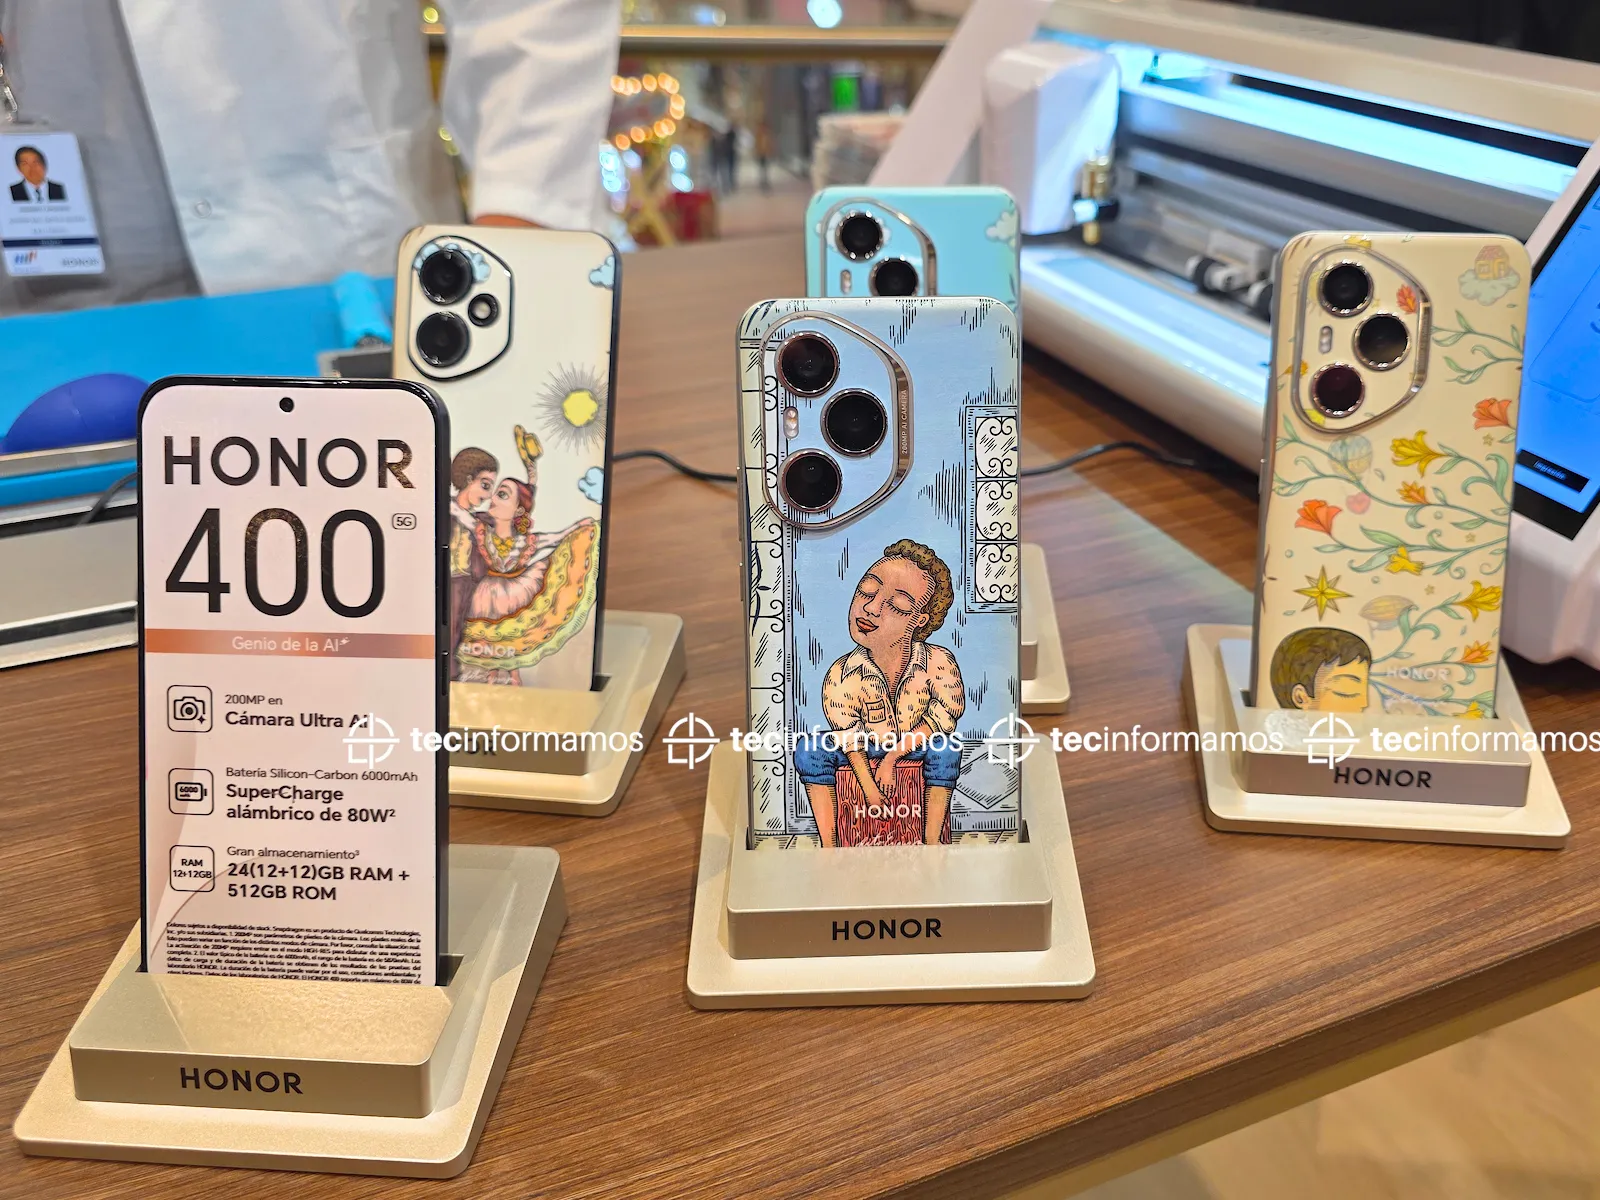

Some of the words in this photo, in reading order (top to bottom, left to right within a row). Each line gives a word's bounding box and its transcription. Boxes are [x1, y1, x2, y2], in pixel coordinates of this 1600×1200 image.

[164, 436, 416, 489] HONOR
[165, 507, 385, 619] 400
[396, 516, 412, 527] 5G
[232, 636, 277, 650] Genio
[281, 637, 301, 651] de
[305, 637, 319, 652] la
[460, 643, 516, 658] HONOR
[1386, 667, 1451, 681] HONOR
[224, 694, 265, 706] 200MP
[268, 697, 283, 706] en
[225, 709, 295, 727] Cámara
[300, 712, 343, 728] Ultra
[226, 767, 267, 779] Batería
[361, 770, 418, 782] 6000mAh
[1334, 766, 1432, 789] HONOR
[226, 784, 344, 804] SuperCharge
[226, 804, 315, 821] alámbrico
[319, 807, 342, 822] de
[855, 804, 922, 819] HONOR
[227, 846, 254, 857] Gran
[181, 858, 203, 867] RAM
[172, 869, 212, 878] 12+12GB
[227, 862, 345, 881] 24(12+12)GB
[350, 866, 393, 882] RAM
[398, 870, 410, 881] +
[228, 884, 287, 899] 512GB
[292, 885, 337, 901] ROM
[832, 918, 942, 941] HONOR
[180, 1067, 303, 1094] HONOR
